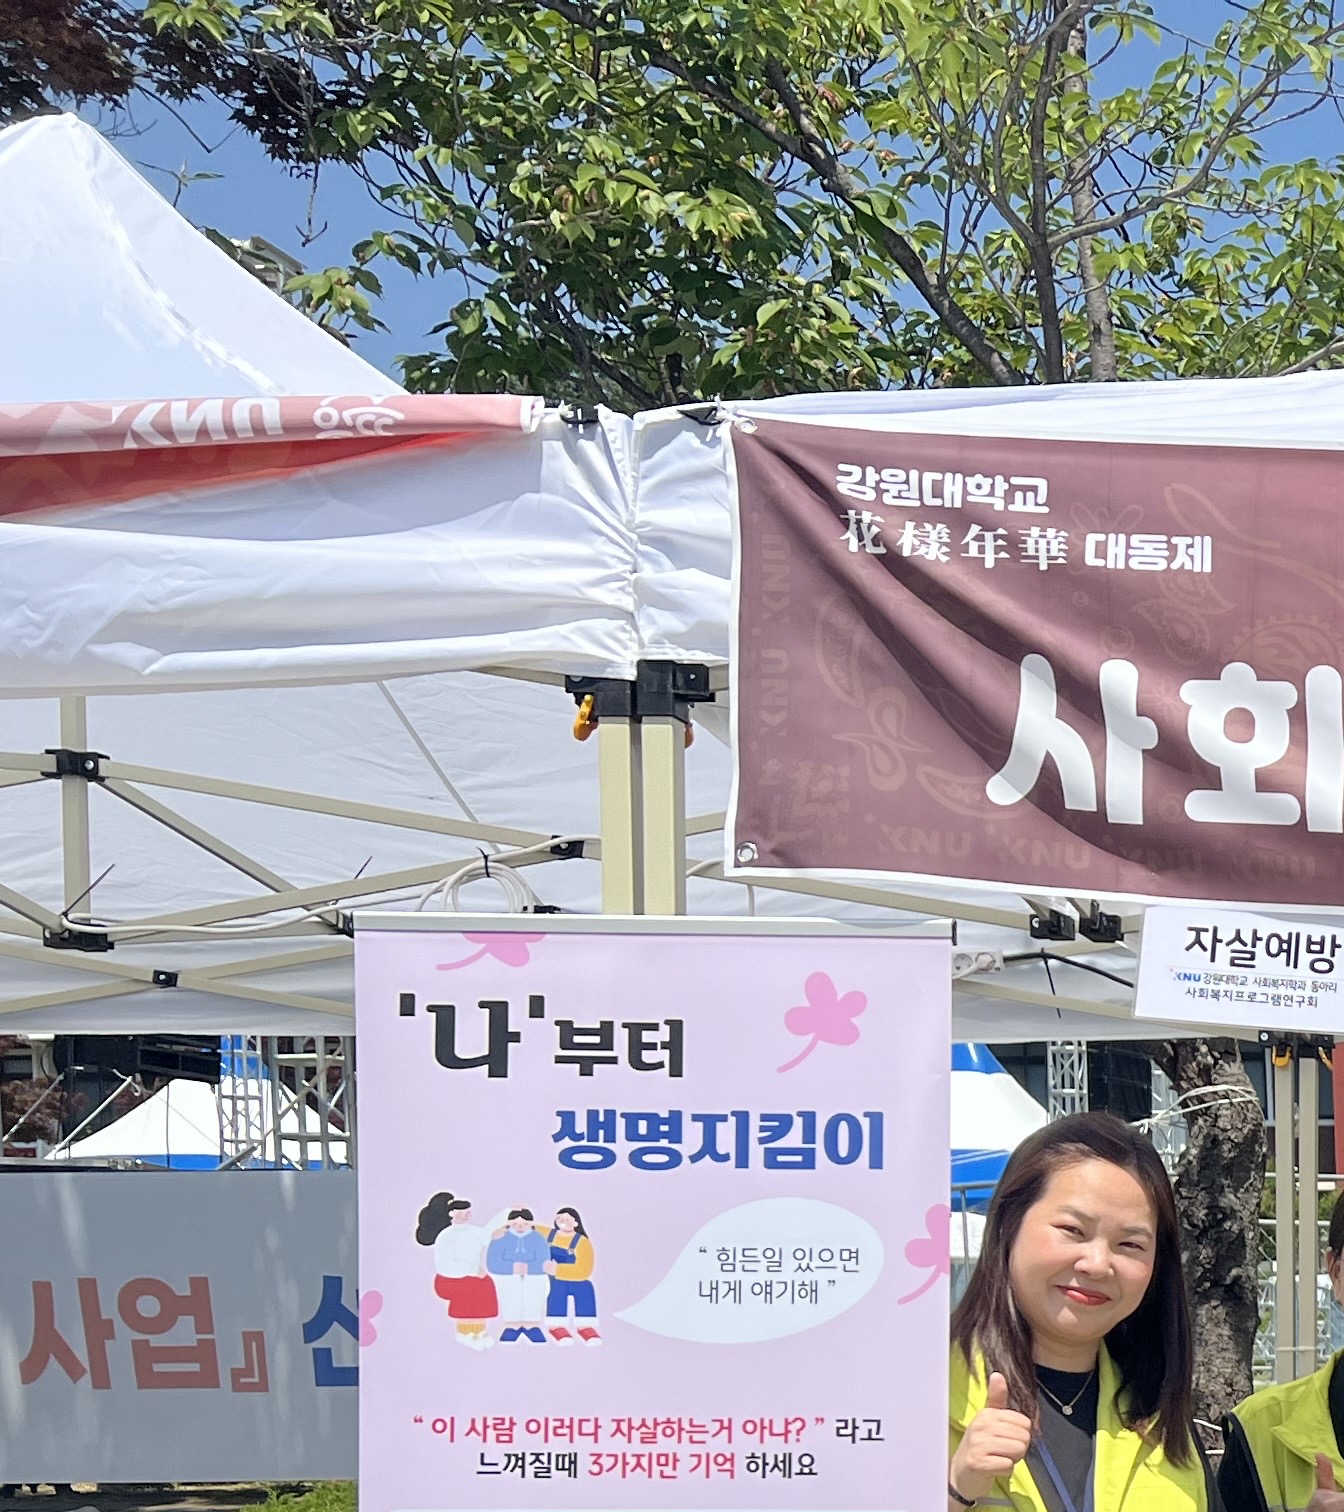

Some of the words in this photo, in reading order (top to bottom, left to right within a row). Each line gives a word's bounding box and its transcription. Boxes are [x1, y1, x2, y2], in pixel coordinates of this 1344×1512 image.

[836, 462, 1049, 514] 강원대학교
[839, 509, 1069, 573] 花樣年華
[1084, 532, 1212, 574] 대동제
[1185, 925, 1342, 974] 자살예방
[1203, 973, 1248, 986] 강원대학교
[1253, 977, 1306, 990] 사회복지학과
[1311, 982, 1338, 993] 동아리
[1185, 987, 1318, 1008] 사회복지프로그램연구회
[551, 1108, 885, 1171] 생명지킴이
[792, 1246, 860, 1273] 있으면
[698, 1279, 743, 1306] 내게
[465, 1416, 516, 1443] 사람
[525, 1417, 601, 1443] 이러다
[610, 1416, 733, 1444] 자살하는거
[835, 1417, 885, 1443] 라고
[476, 1451, 578, 1479] 느껴질때
[587, 1450, 680, 1479] 3가지만
[688, 1450, 736, 1479] 기억
[745, 1451, 818, 1479] 하세요
